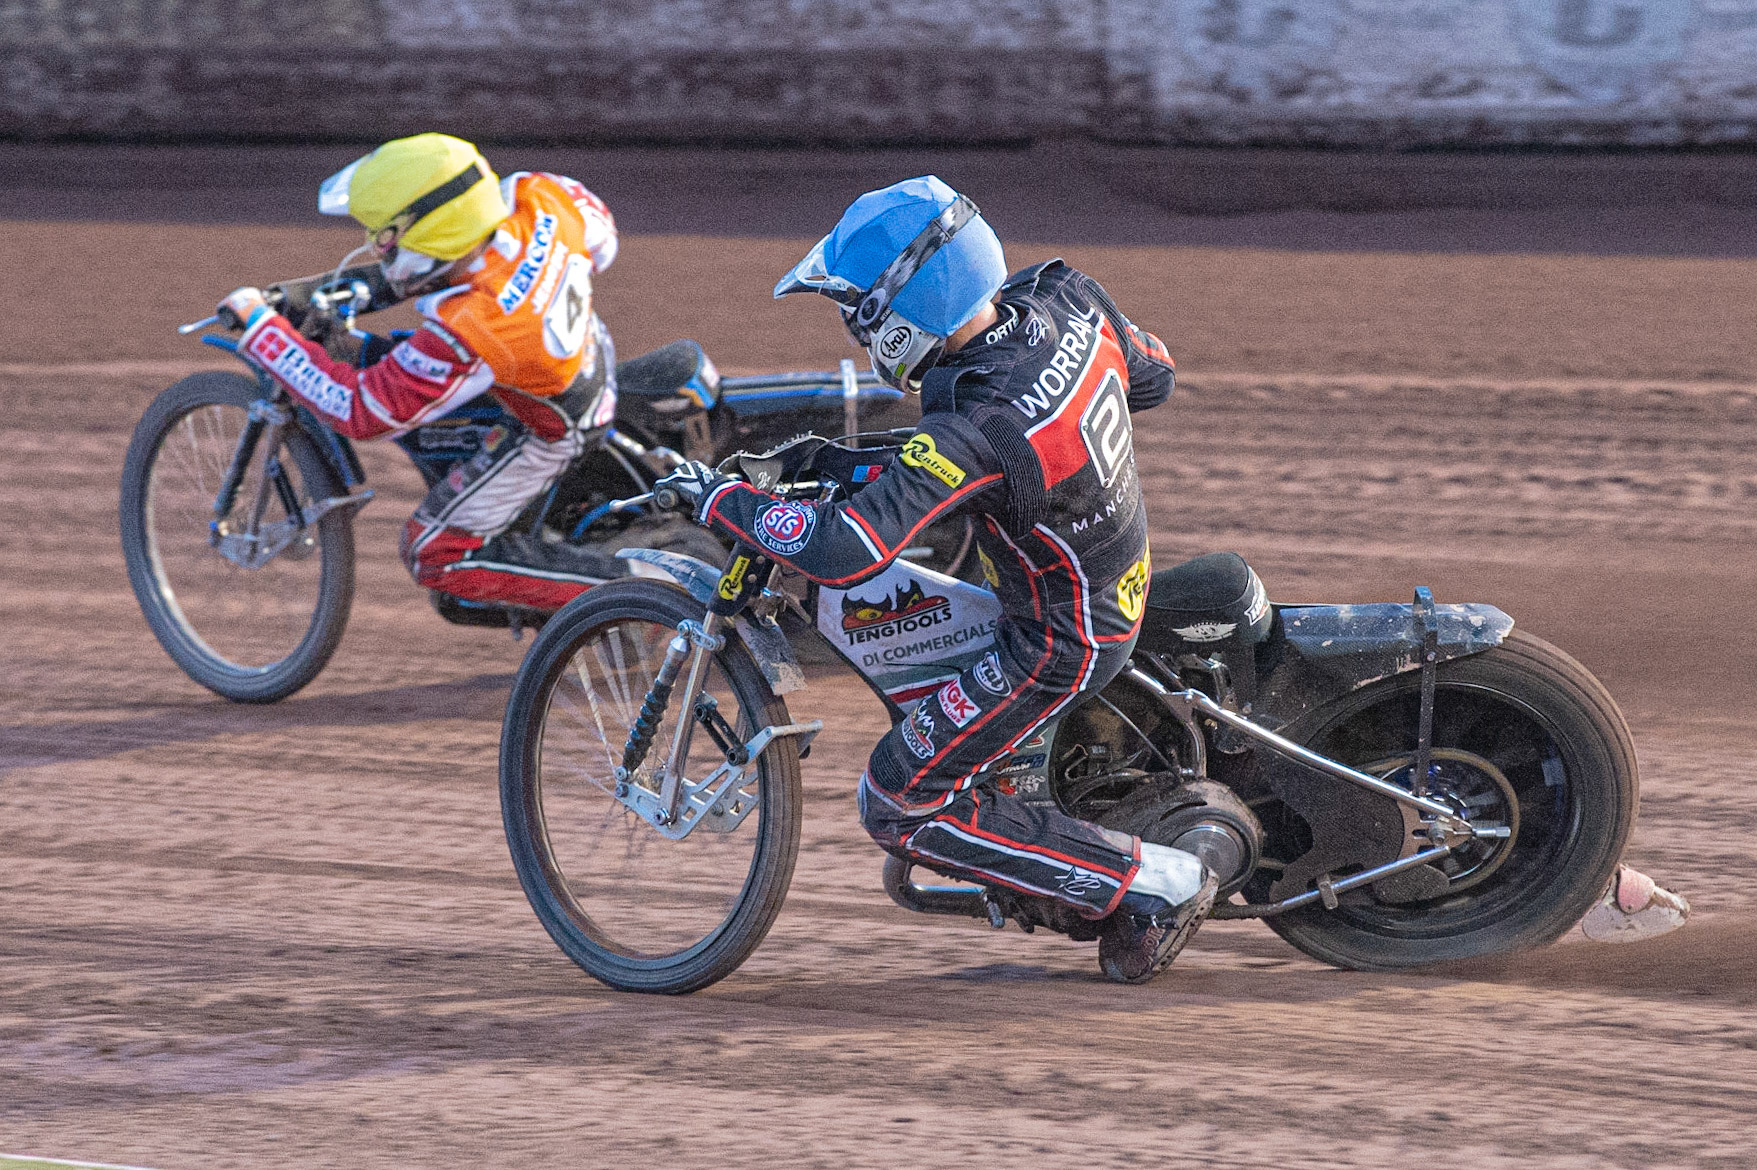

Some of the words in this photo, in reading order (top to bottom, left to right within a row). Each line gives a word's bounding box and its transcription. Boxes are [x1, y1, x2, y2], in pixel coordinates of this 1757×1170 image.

[883, 331, 908, 357] Arai
[1091, 394, 1129, 471] 2
[903, 439, 959, 484] Rentruck
[766, 509, 799, 536] STS
[768, 538, 804, 552] SERVICES
[720, 559, 748, 595] Rentruck
[844, 607, 952, 645] TENGTOOLS
[862, 653, 880, 667] DI
[883, 619, 997, 662] COMMERCIALS
[944, 703, 962, 723] PLUGS
